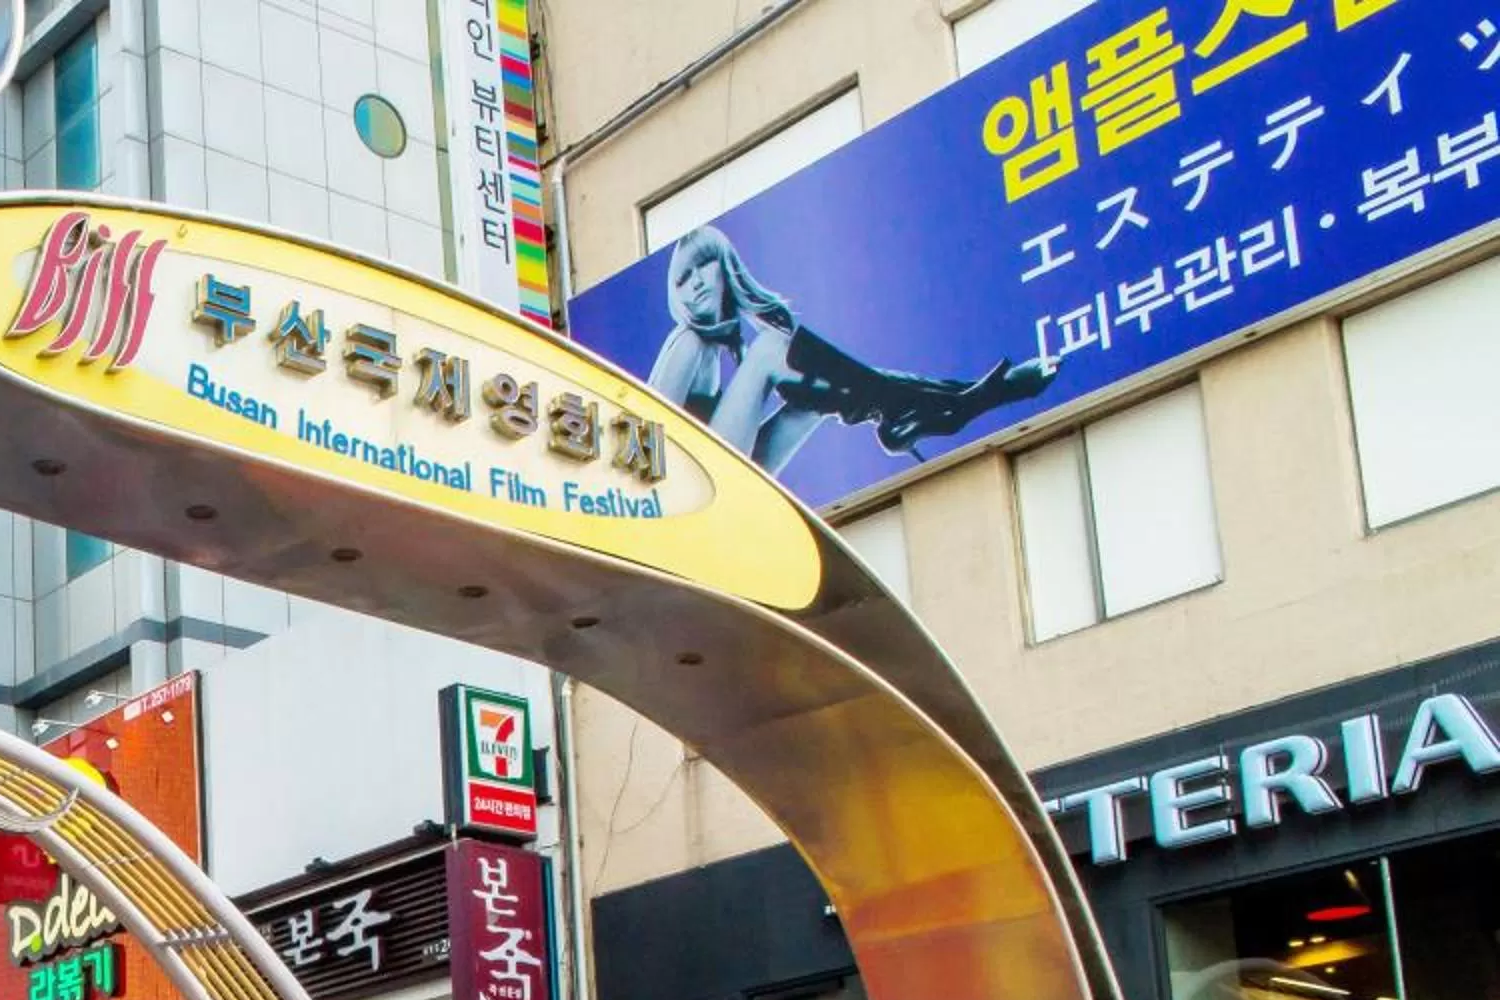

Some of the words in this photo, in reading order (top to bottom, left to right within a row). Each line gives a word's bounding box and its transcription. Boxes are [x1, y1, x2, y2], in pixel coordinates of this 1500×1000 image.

[466, 0, 494, 62] 인
[981, 0, 1400, 204] 앰플스
[471, 78, 511, 265] 뷰티센터
[186, 362, 279, 431] Busan
[297, 408, 473, 494] International
[489, 466, 548, 509] Film
[563, 481, 663, 521] Festival
[192, 272, 669, 486] 부산국제영화제
[283, 888, 392, 972] 본죽
